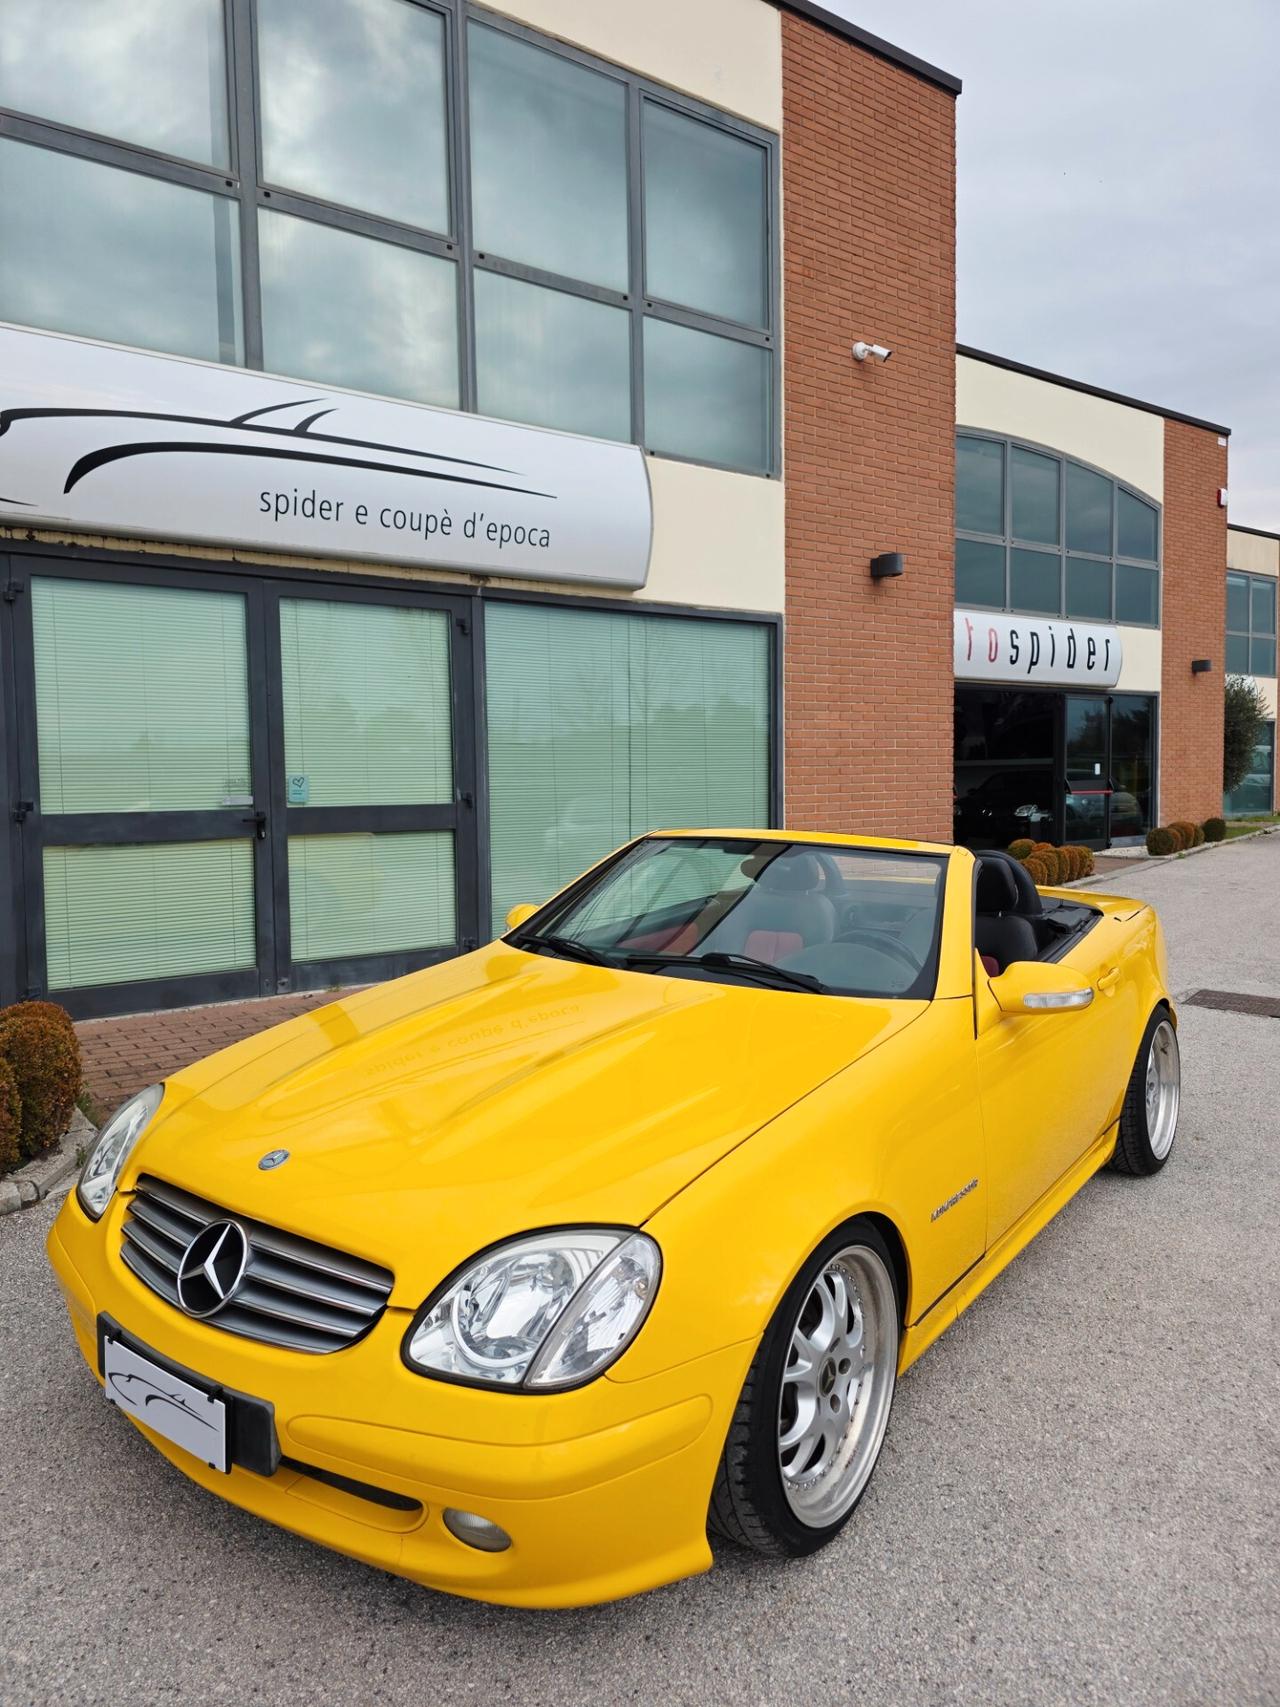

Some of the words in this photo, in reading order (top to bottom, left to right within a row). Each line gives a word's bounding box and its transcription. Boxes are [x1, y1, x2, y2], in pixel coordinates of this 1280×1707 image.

[259, 488, 344, 522] spider
[355, 504, 368, 525] e
[380, 508, 452, 540] coupè
[463, 512, 551, 549] d'epoca
